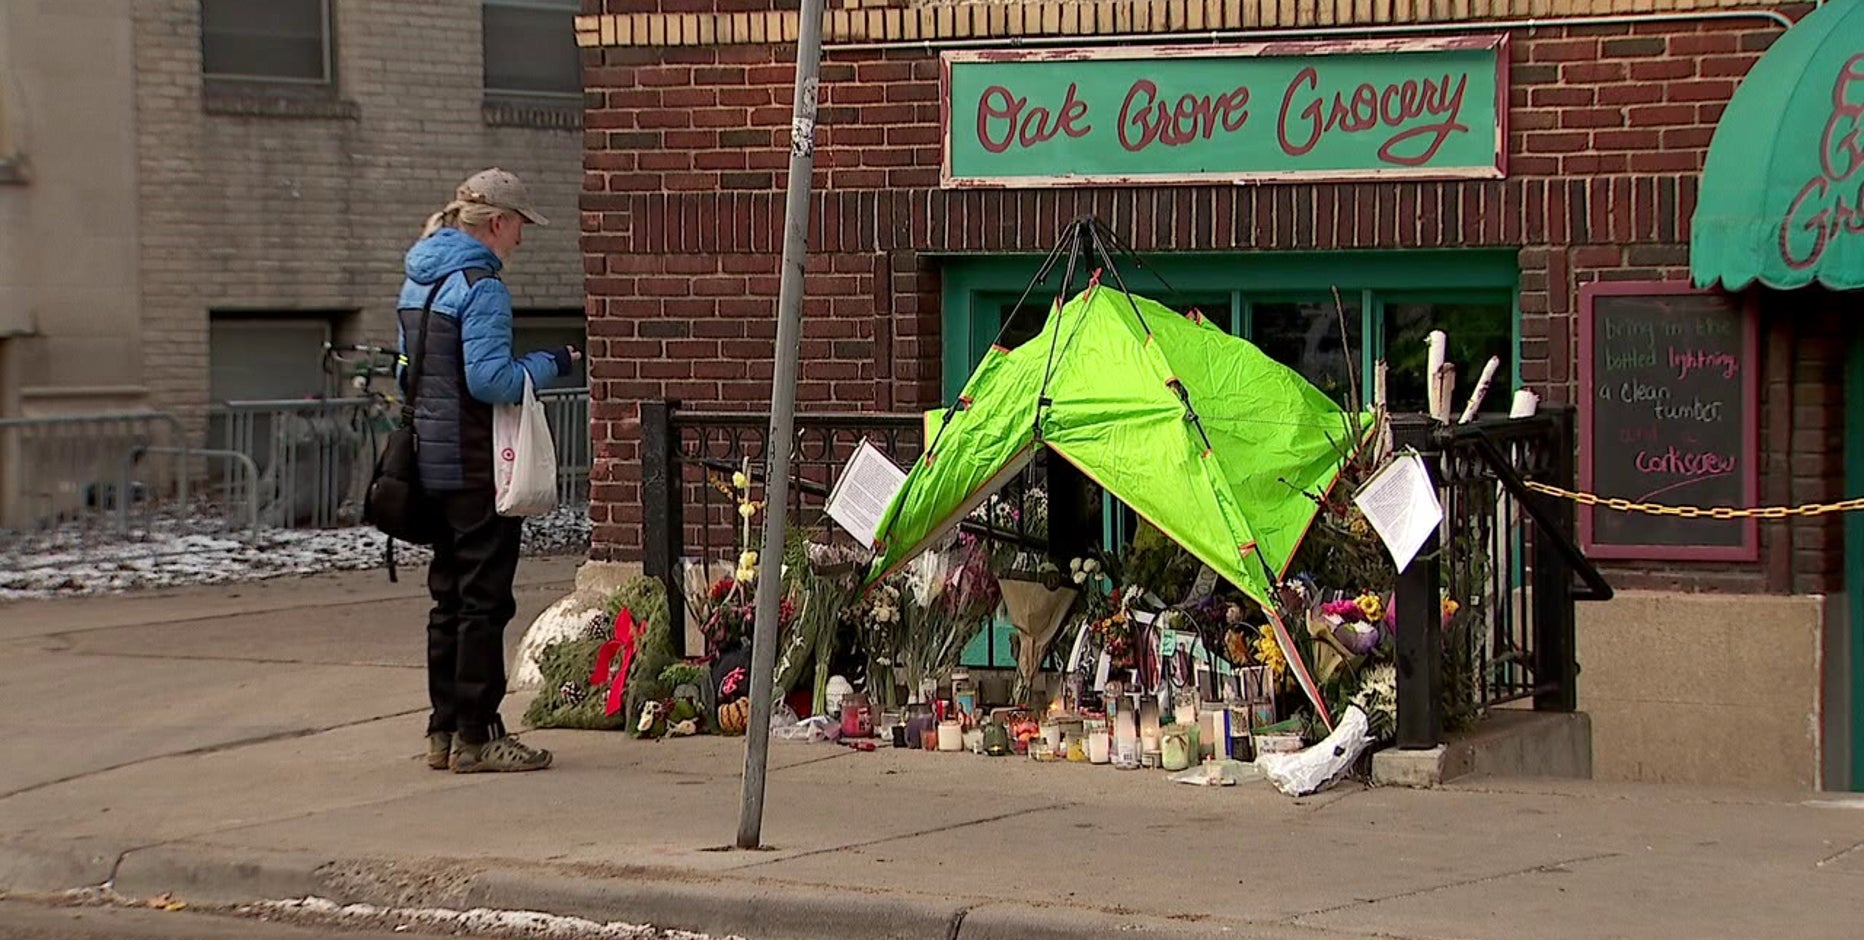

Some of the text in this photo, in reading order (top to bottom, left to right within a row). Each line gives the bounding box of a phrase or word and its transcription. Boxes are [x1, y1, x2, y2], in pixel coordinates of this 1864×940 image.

[976, 66, 1469, 166] Oak Grove Grocery
[1606, 317, 1655, 348] bring
[1605, 347, 1656, 371] bottled
[1599, 383, 1612, 401] a
